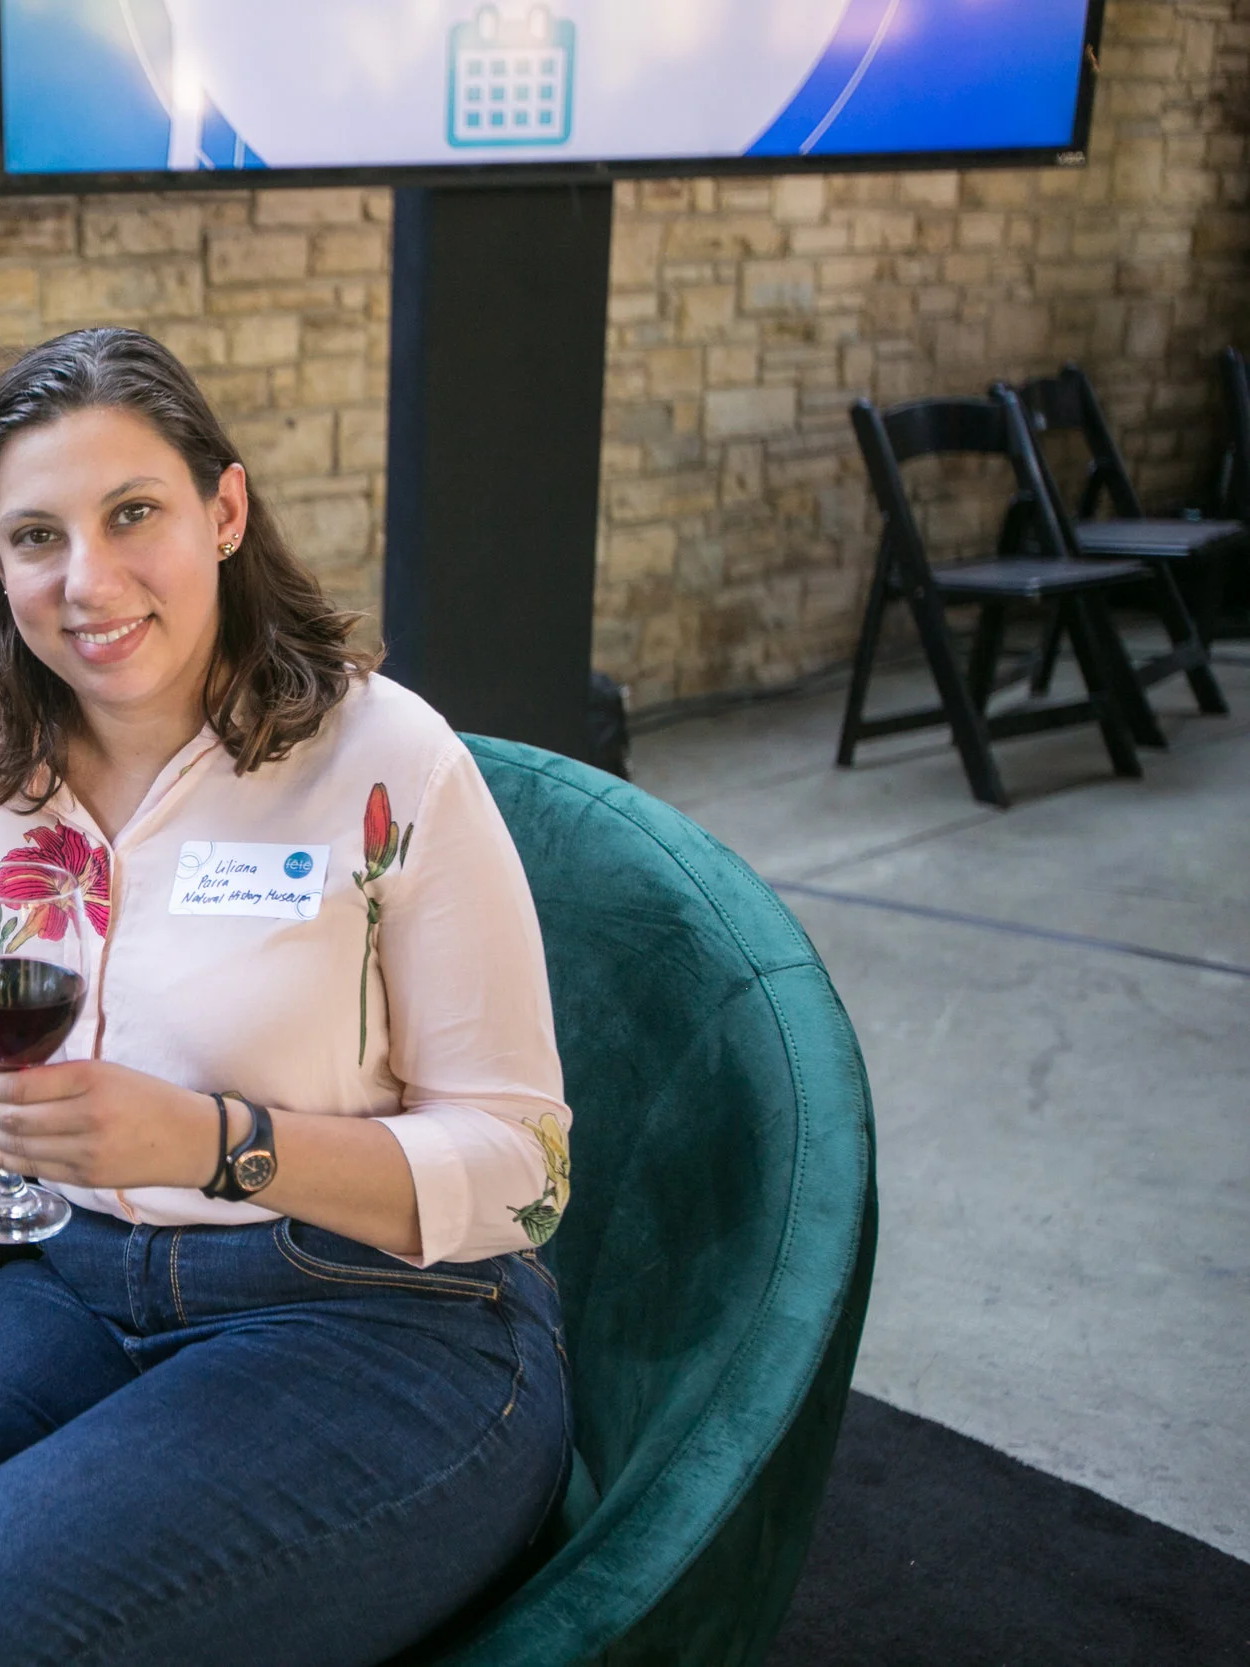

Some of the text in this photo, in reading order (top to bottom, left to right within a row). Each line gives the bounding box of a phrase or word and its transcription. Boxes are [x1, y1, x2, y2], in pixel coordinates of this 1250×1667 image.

[215, 859, 258, 875] Liliana
[198, 874, 230, 890] Parra
[181, 889, 312, 905] Natural History Museum
